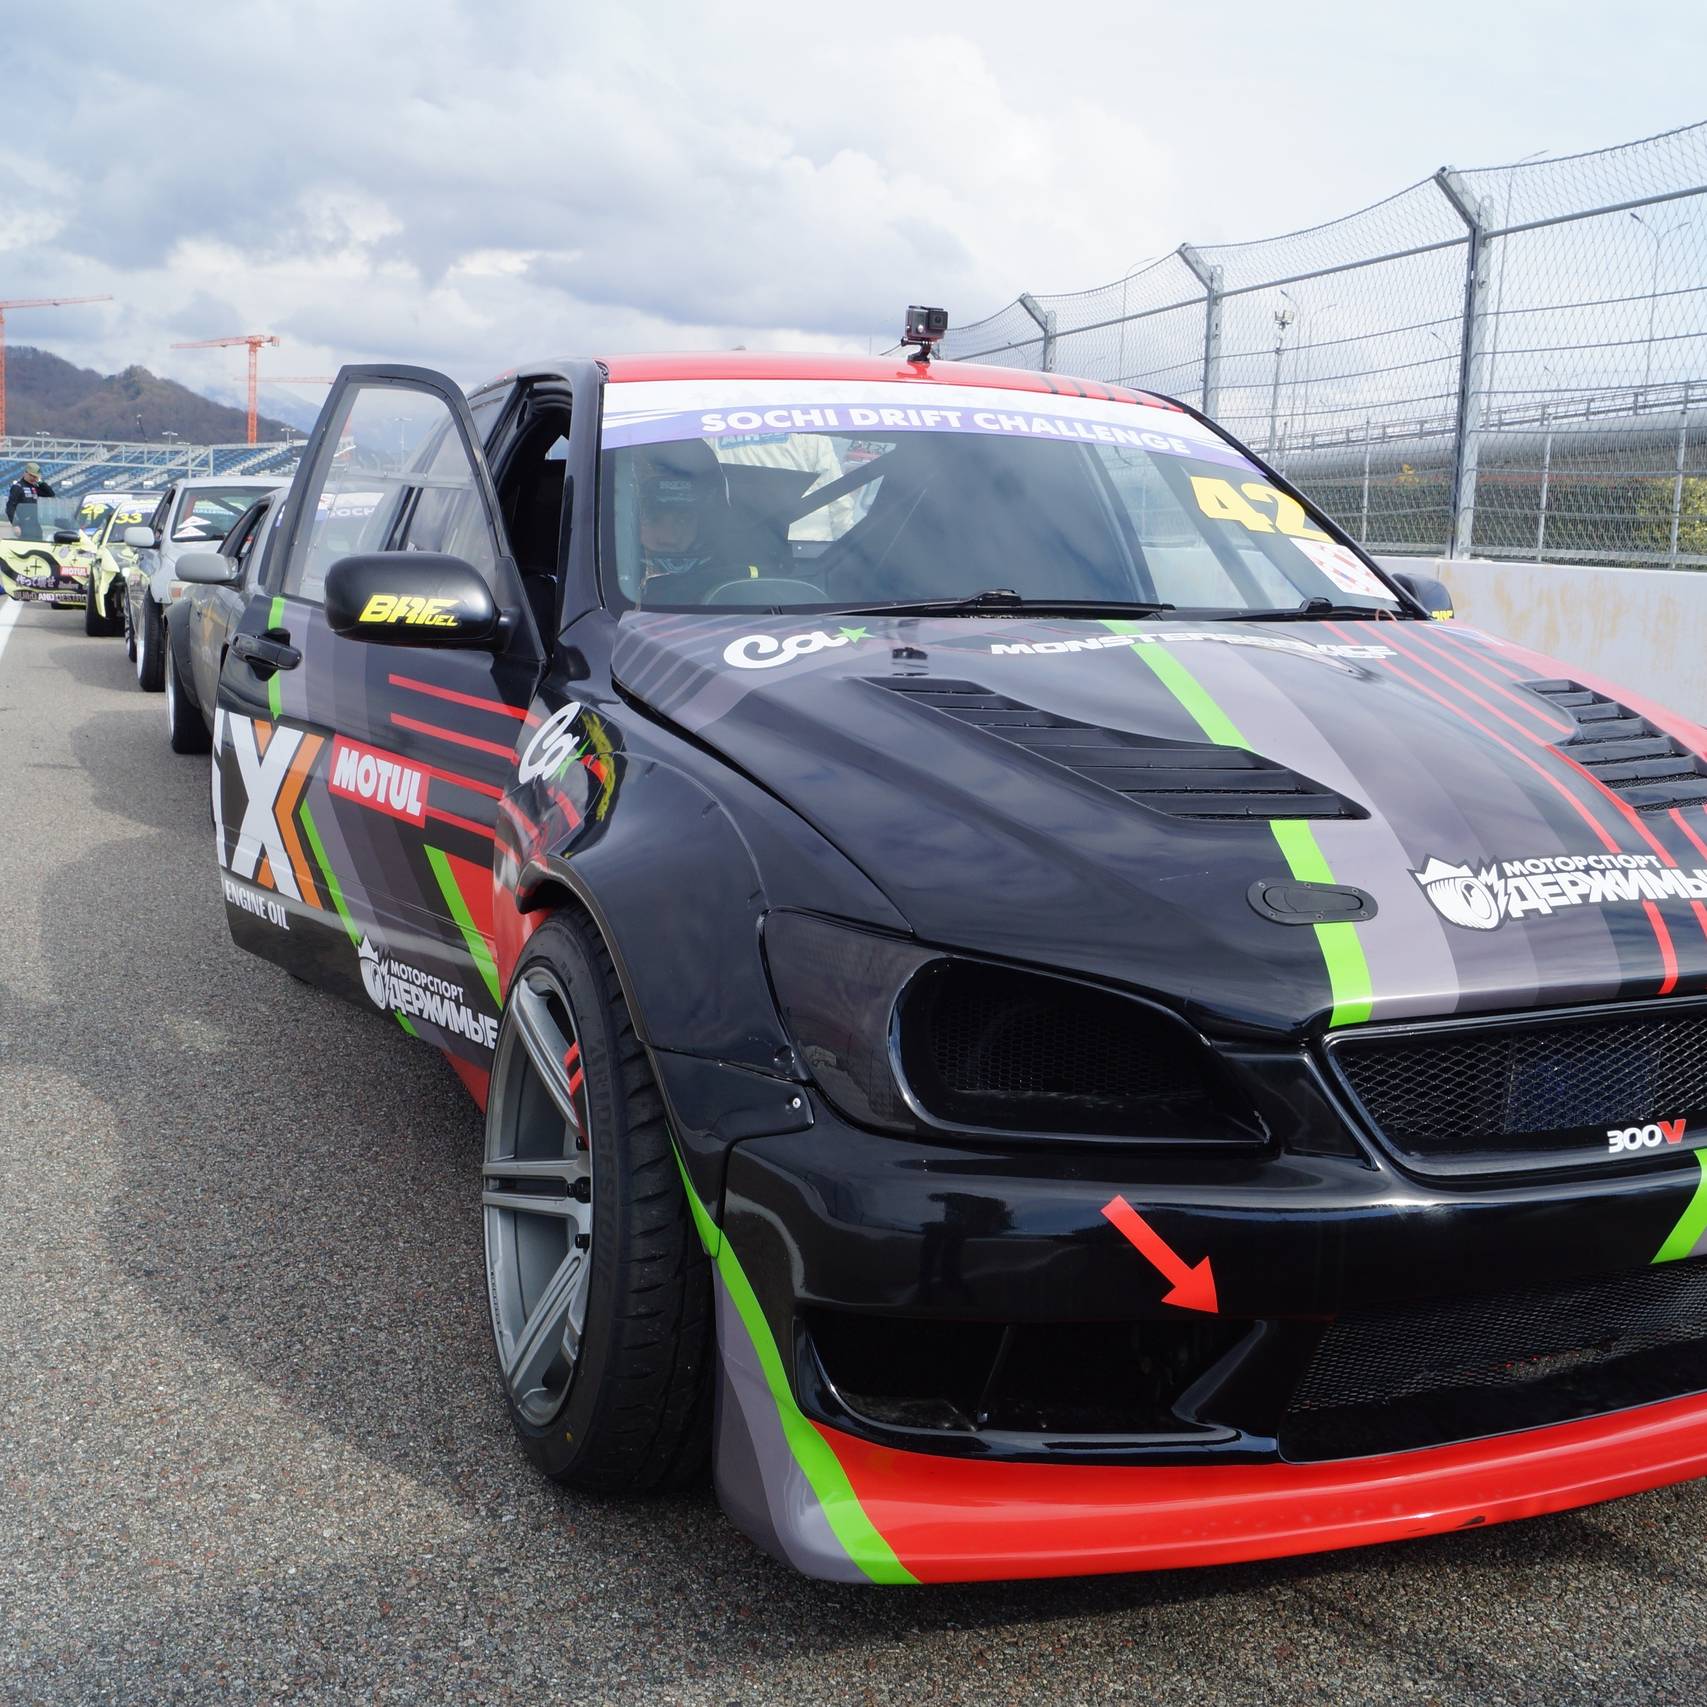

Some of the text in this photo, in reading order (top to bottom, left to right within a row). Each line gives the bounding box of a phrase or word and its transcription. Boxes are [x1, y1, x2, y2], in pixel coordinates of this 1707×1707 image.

[701, 408, 1192, 455] SOCHI DRIFT CHALLENGE
[115, 512, 142, 524] 33
[1190, 476, 1336, 544] 42
[332, 746, 423, 817] MOTUL
[1503, 854, 1662, 877] МОТОРСПОРТ
[225, 879, 291, 931] ENGINE OIL
[1507, 868, 1707, 919] ДЕРЖИМЫ
[391, 959, 464, 1003] МОТОРСПОРТ
[388, 975, 499, 1050] ДЕРЖИМЫЕ
[1607, 1118, 1687, 1154] 300V
